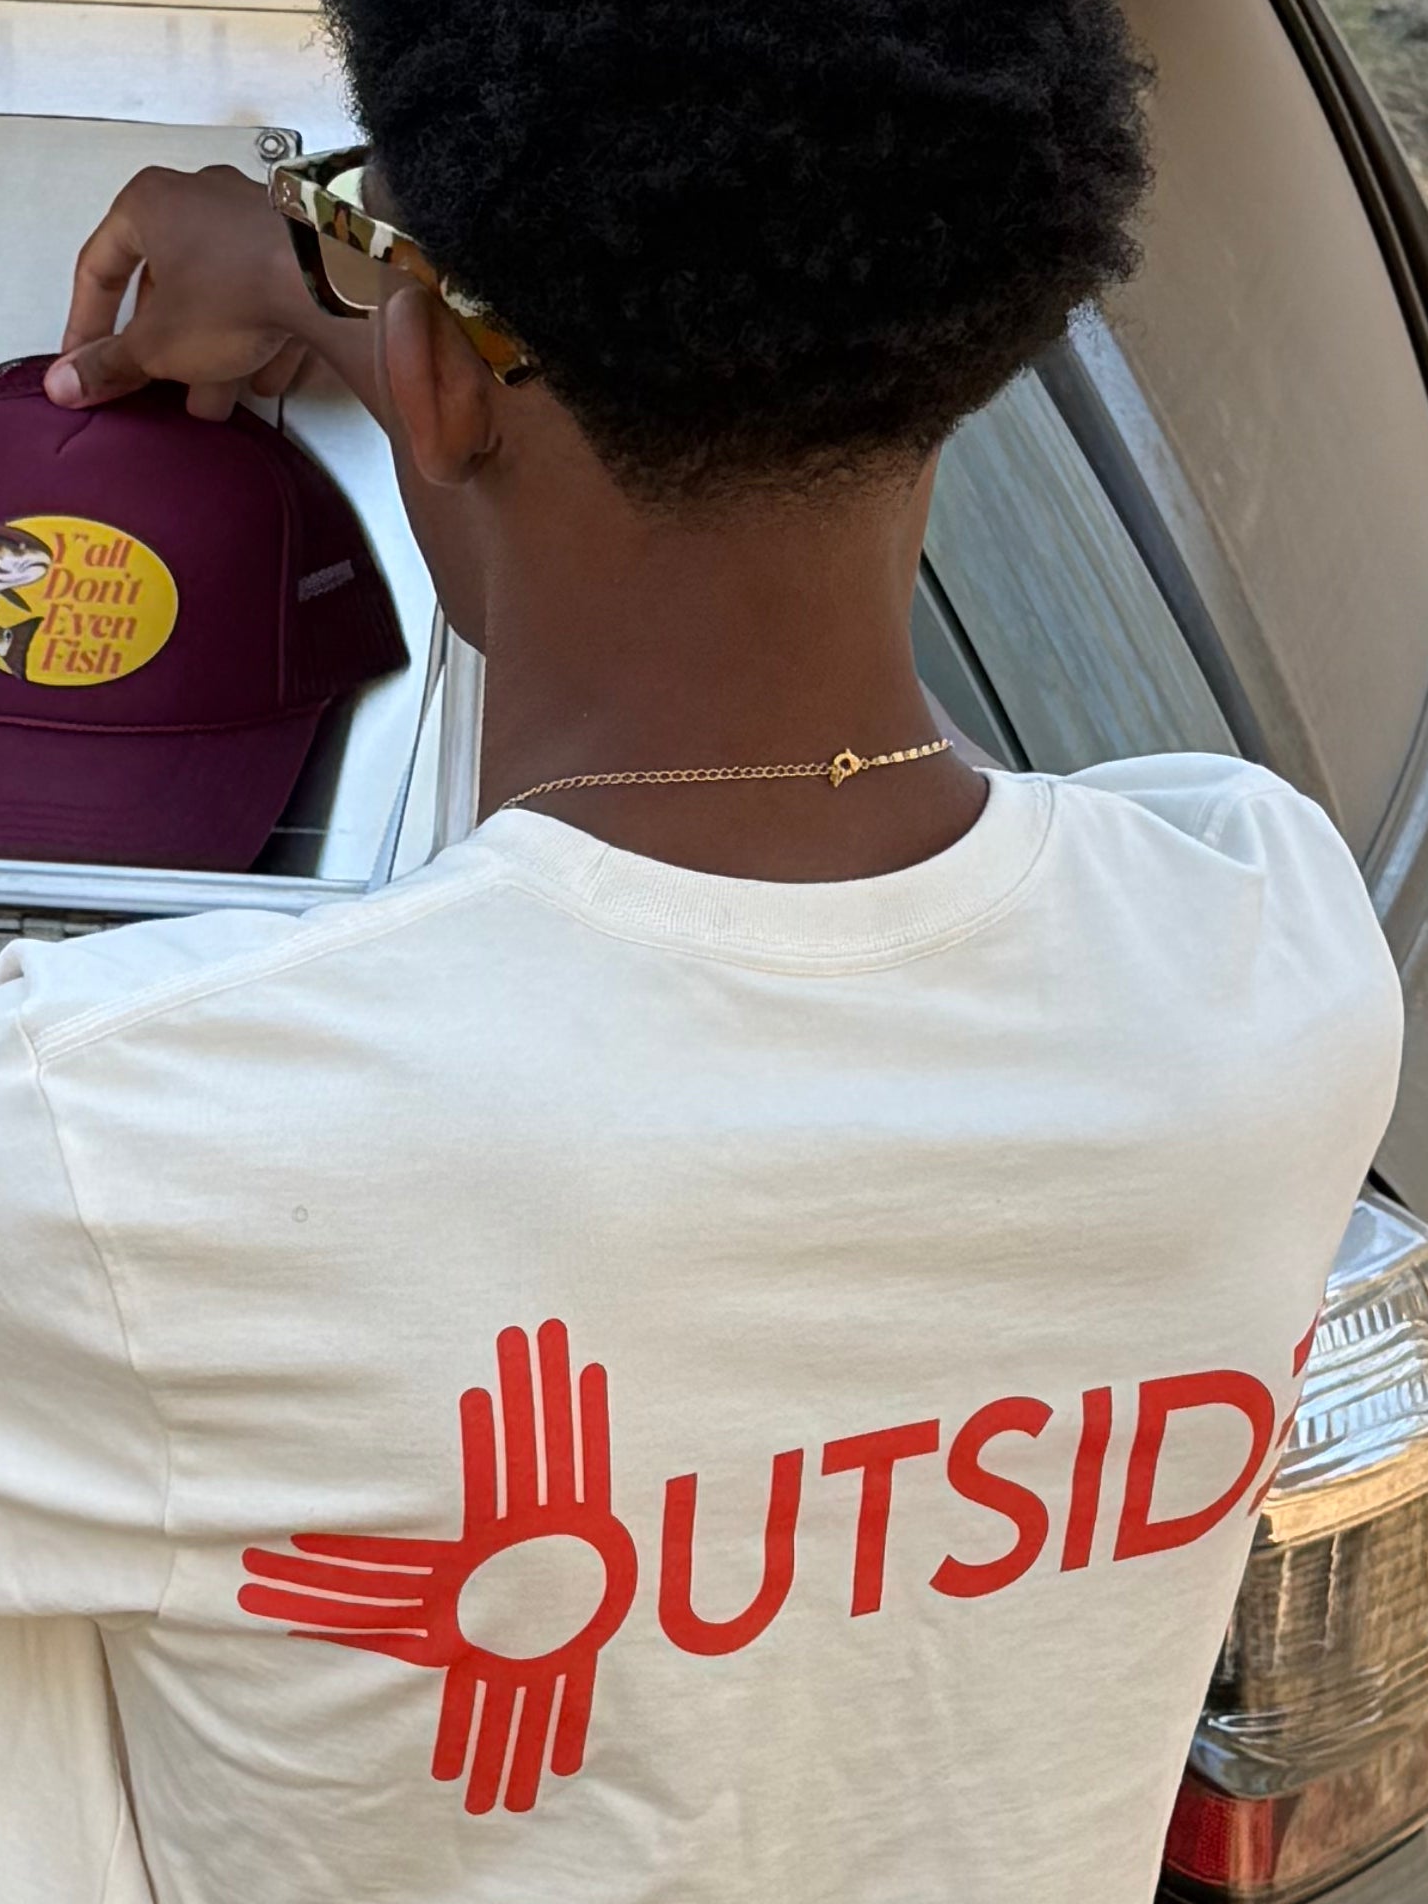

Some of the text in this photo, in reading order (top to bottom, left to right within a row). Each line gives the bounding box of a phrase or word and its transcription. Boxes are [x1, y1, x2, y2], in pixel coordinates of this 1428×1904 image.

[44, 567, 143, 605] Don't
[42, 603, 137, 640] Even
[40, 638, 122, 674] Fish
[237, 1318, 1321, 1815] OUTSID
